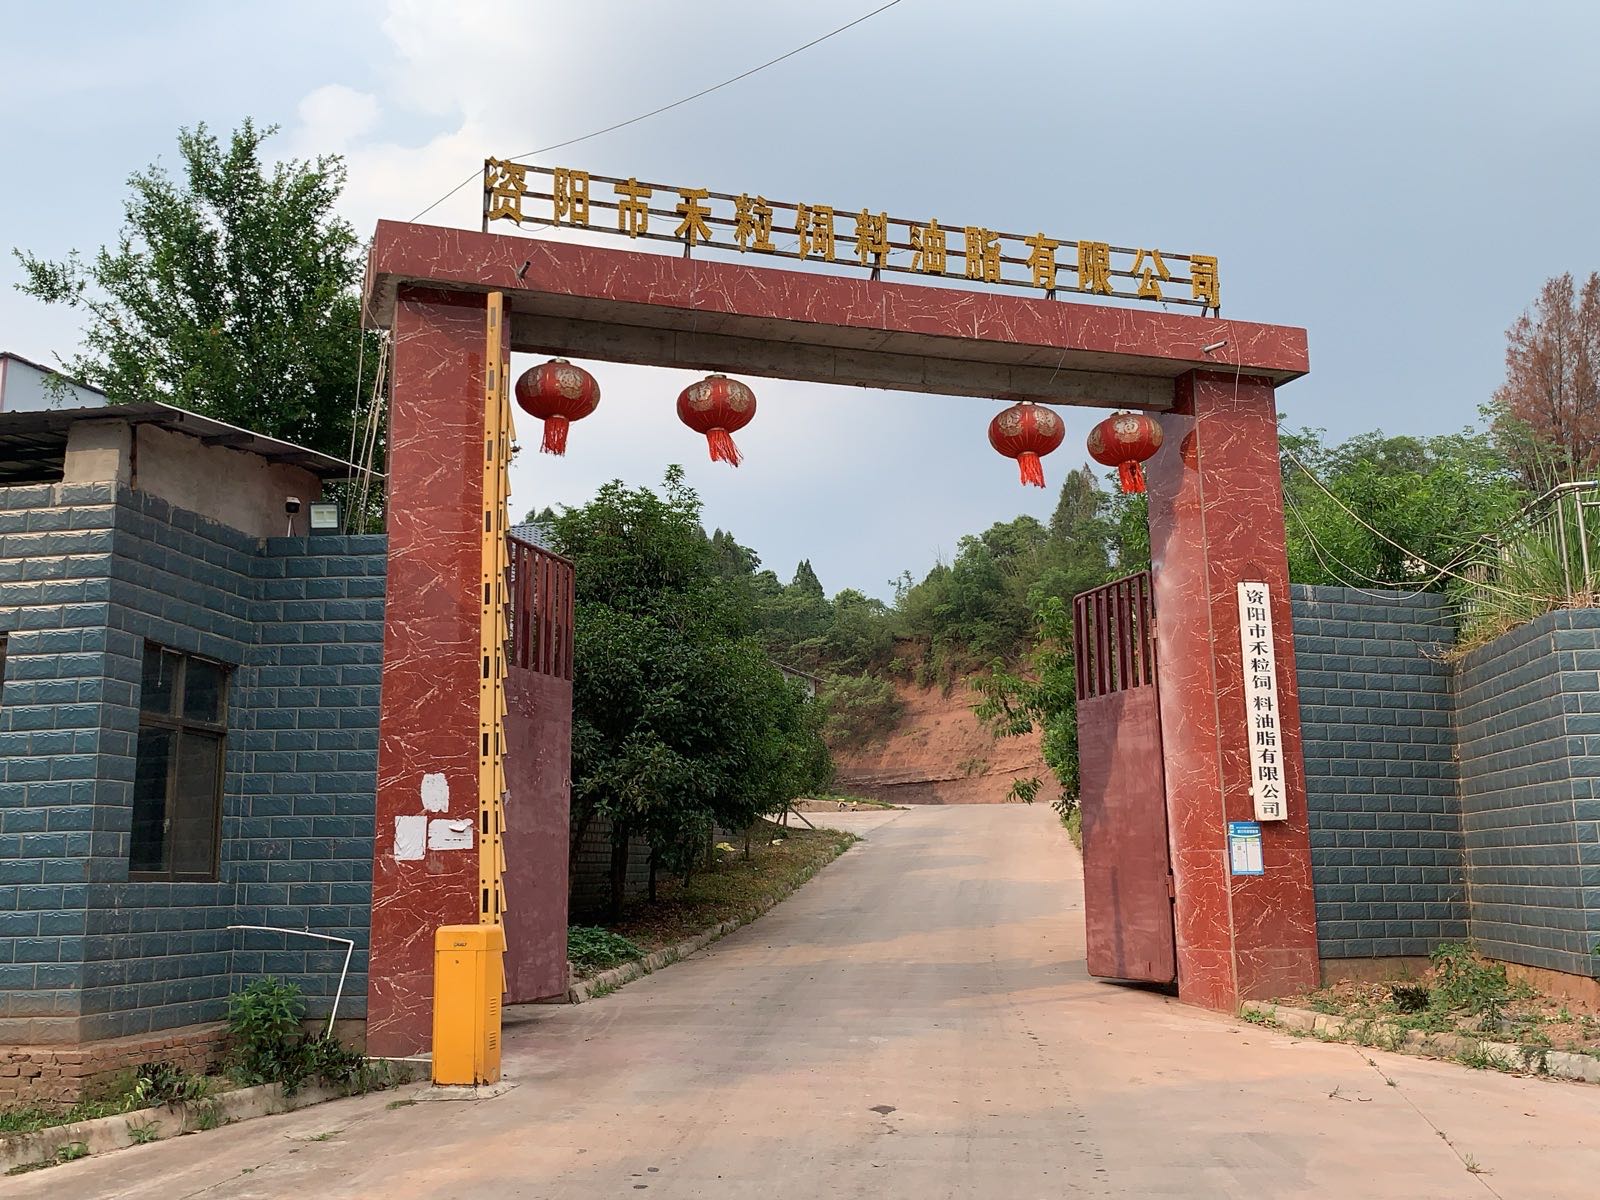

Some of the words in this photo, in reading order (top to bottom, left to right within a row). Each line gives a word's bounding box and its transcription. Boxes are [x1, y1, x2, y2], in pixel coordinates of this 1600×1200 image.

[485, 156, 1220, 308] 资阳市禾粒饲料油脂有限公司
[1245, 588, 1281, 818] 资阳市禾粒饲料油脂有限公司
